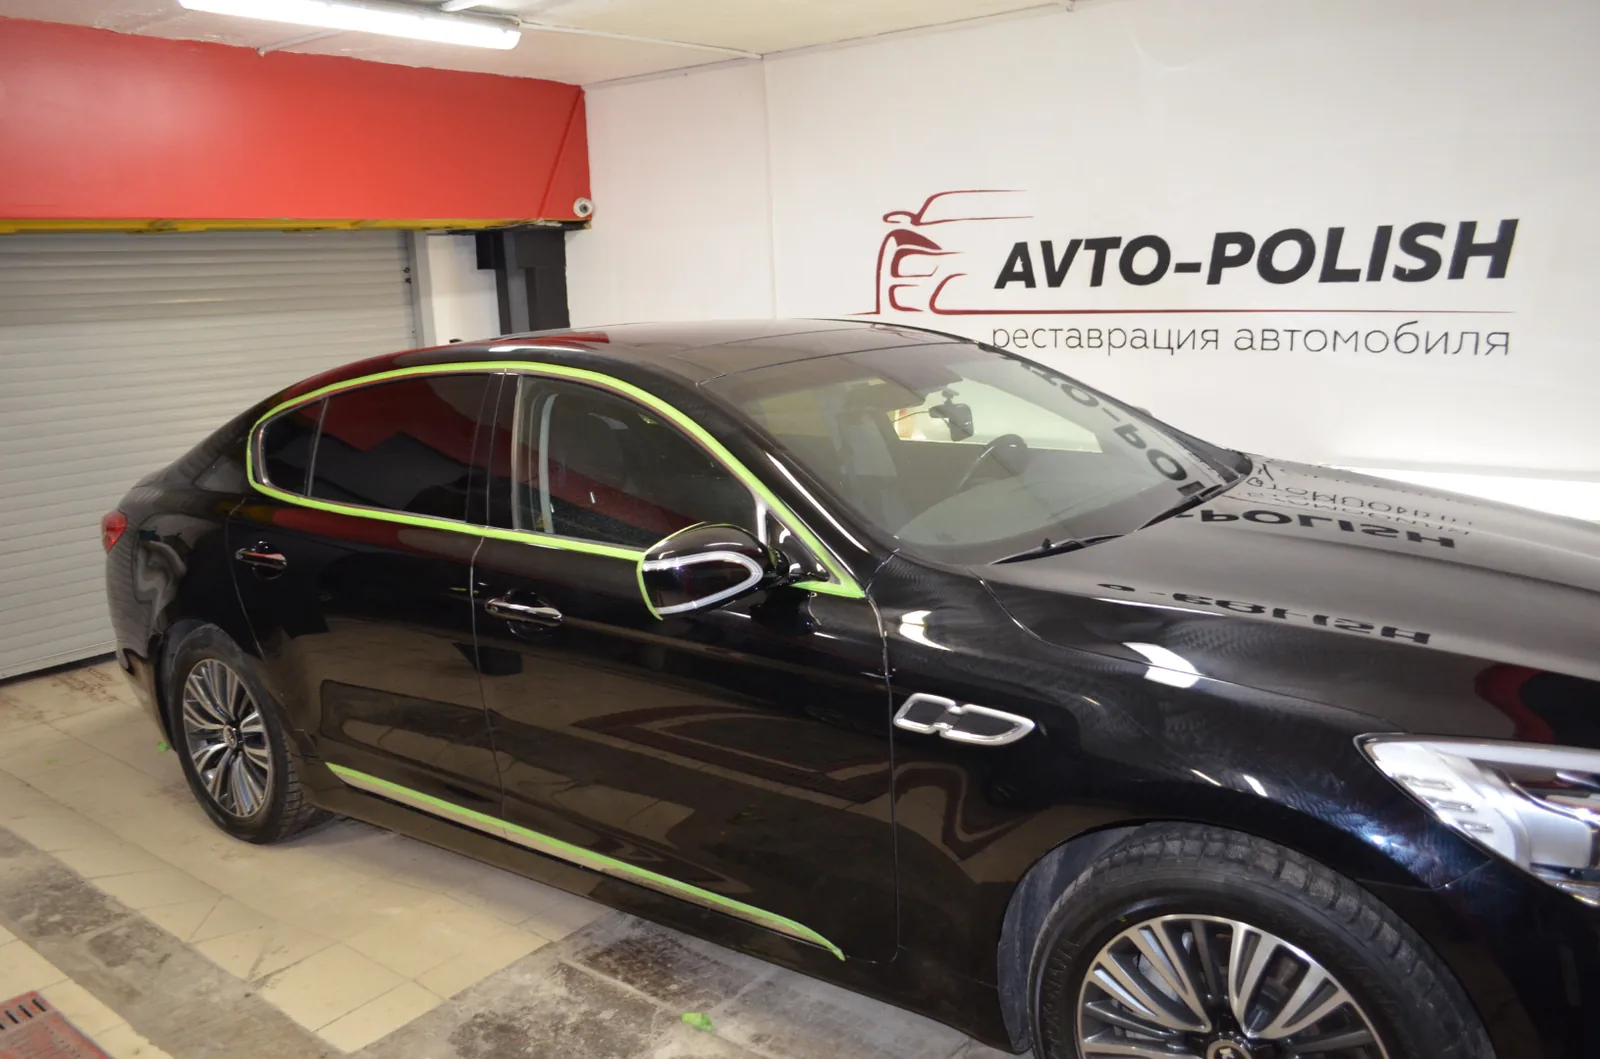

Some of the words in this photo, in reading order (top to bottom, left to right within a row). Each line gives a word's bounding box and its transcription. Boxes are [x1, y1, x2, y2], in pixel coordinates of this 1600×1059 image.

[993, 218, 1519, 289] AVTO-POLISH
[992, 328, 1218, 356] реставрация
[1234, 320, 1509, 356] автомобиля
